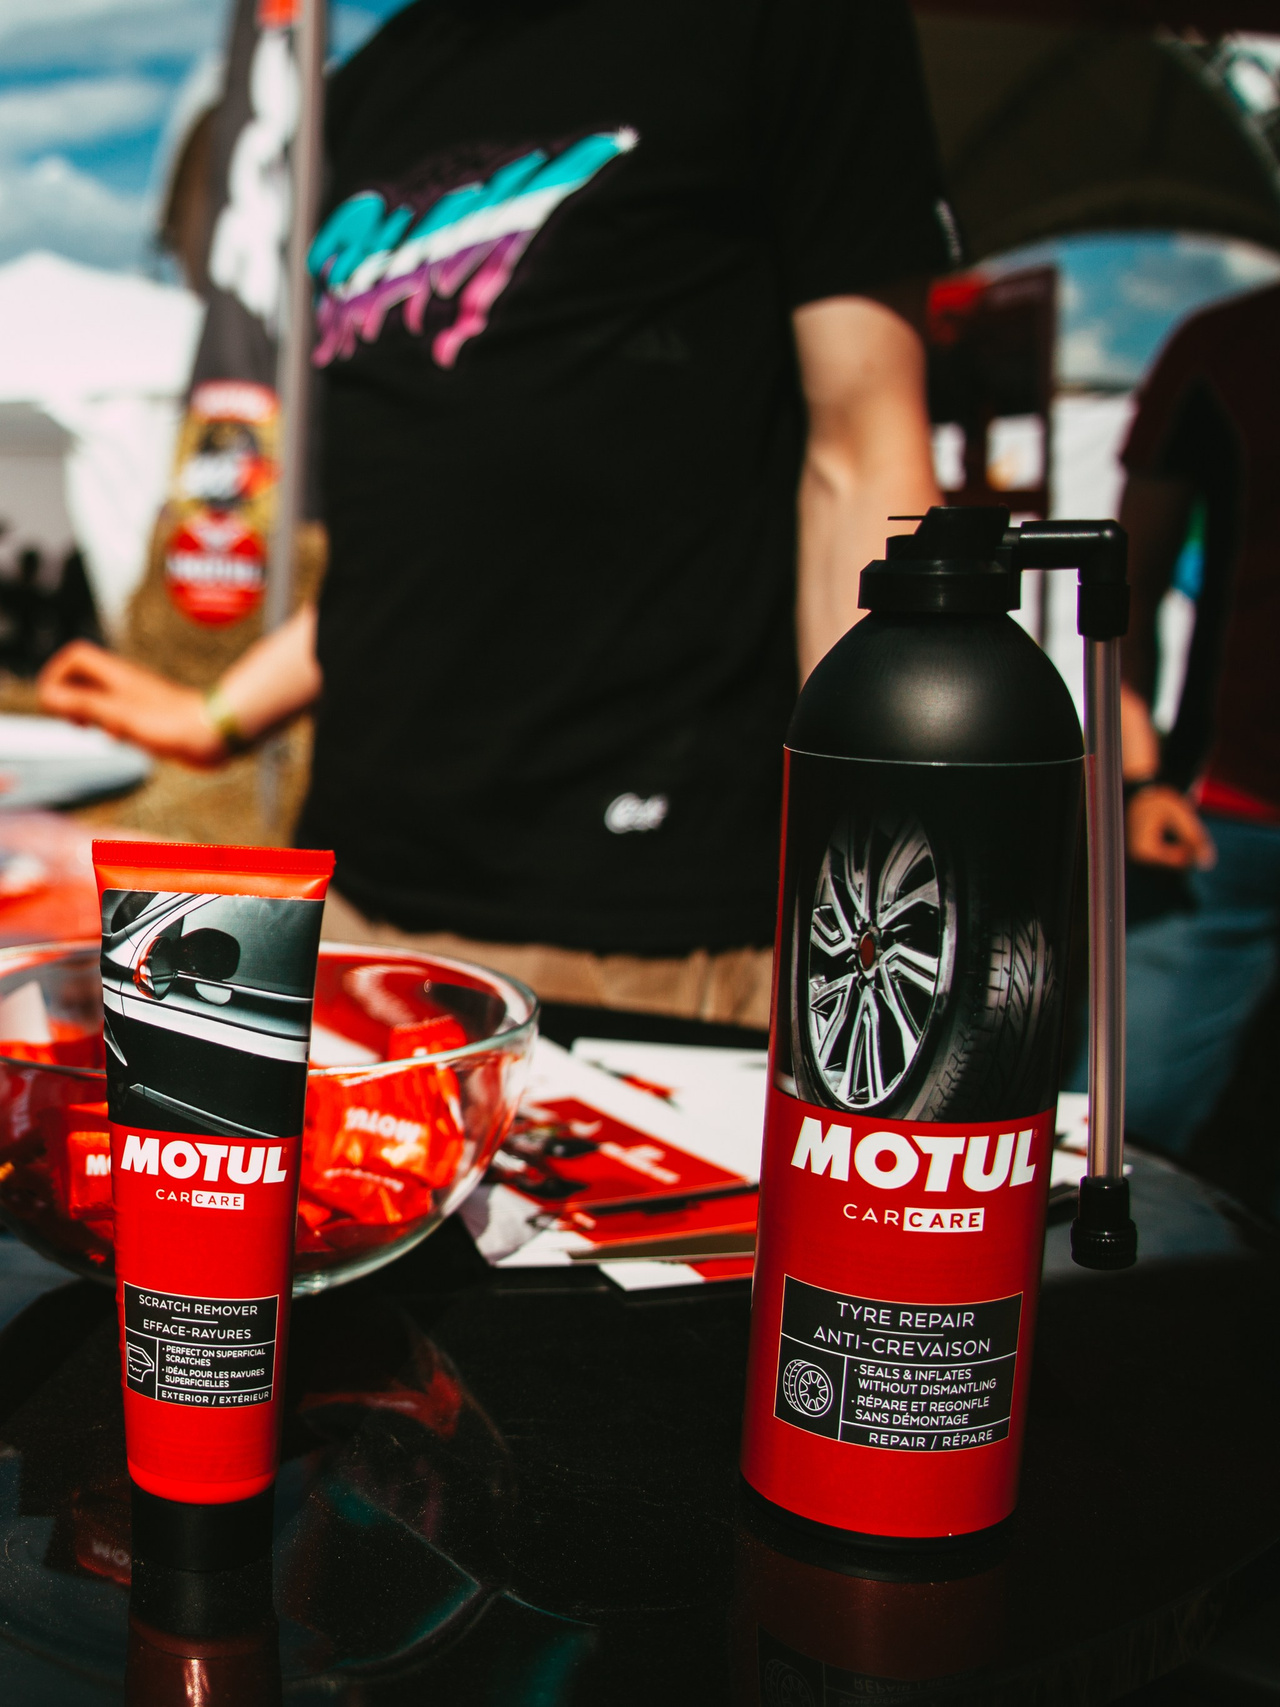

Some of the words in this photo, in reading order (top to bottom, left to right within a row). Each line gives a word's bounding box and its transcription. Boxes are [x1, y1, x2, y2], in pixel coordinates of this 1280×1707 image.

[120, 1134, 288, 1185] MOTUL
[791, 1116, 1036, 1193] MOTUL
[138, 1293, 191, 1314] SCRATCH
[194, 1303, 258, 1317] REMOVER
[836, 1300, 892, 1326] TYRE
[899, 1311, 975, 1328] REPAIR
[142, 1318, 252, 1340] EFFACE-RAYURES
[812, 1325, 991, 1357] ANTI-CREVAISON
[165, 1353, 211, 1367] SCRATCHES
[202, 1347, 216, 1357] ON
[216, 1346, 266, 1358] SUPERFICIAL
[165, 1374, 230, 1388] SUPERFICIELLES
[189, 1368, 213, 1379] POUR
[213, 1369, 230, 1379] LES
[230, 1367, 265, 1379] RAYURES
[859, 1364, 901, 1380] SEALS
[902, 1368, 912, 1380] &
[914, 1368, 972, 1381] INFLATES
[858, 1377, 918, 1395] WITHOUT
[920, 1377, 997, 1395] DISMANTLING
[161, 1390, 210, 1404] EXTERIOR
[219, 1390, 270, 1405] EXTÉRIEUR
[856, 1394, 907, 1411] RÉPARE
[910, 1400, 927, 1412] ET
[929, 1396, 990, 1412] REGONFLE
[855, 1409, 889, 1424] SANS
[892, 1412, 969, 1427] DÉMONTAGE
[868, 1431, 926, 1448] REPAIR
[942, 1429, 993, 1447] RÉPARE
